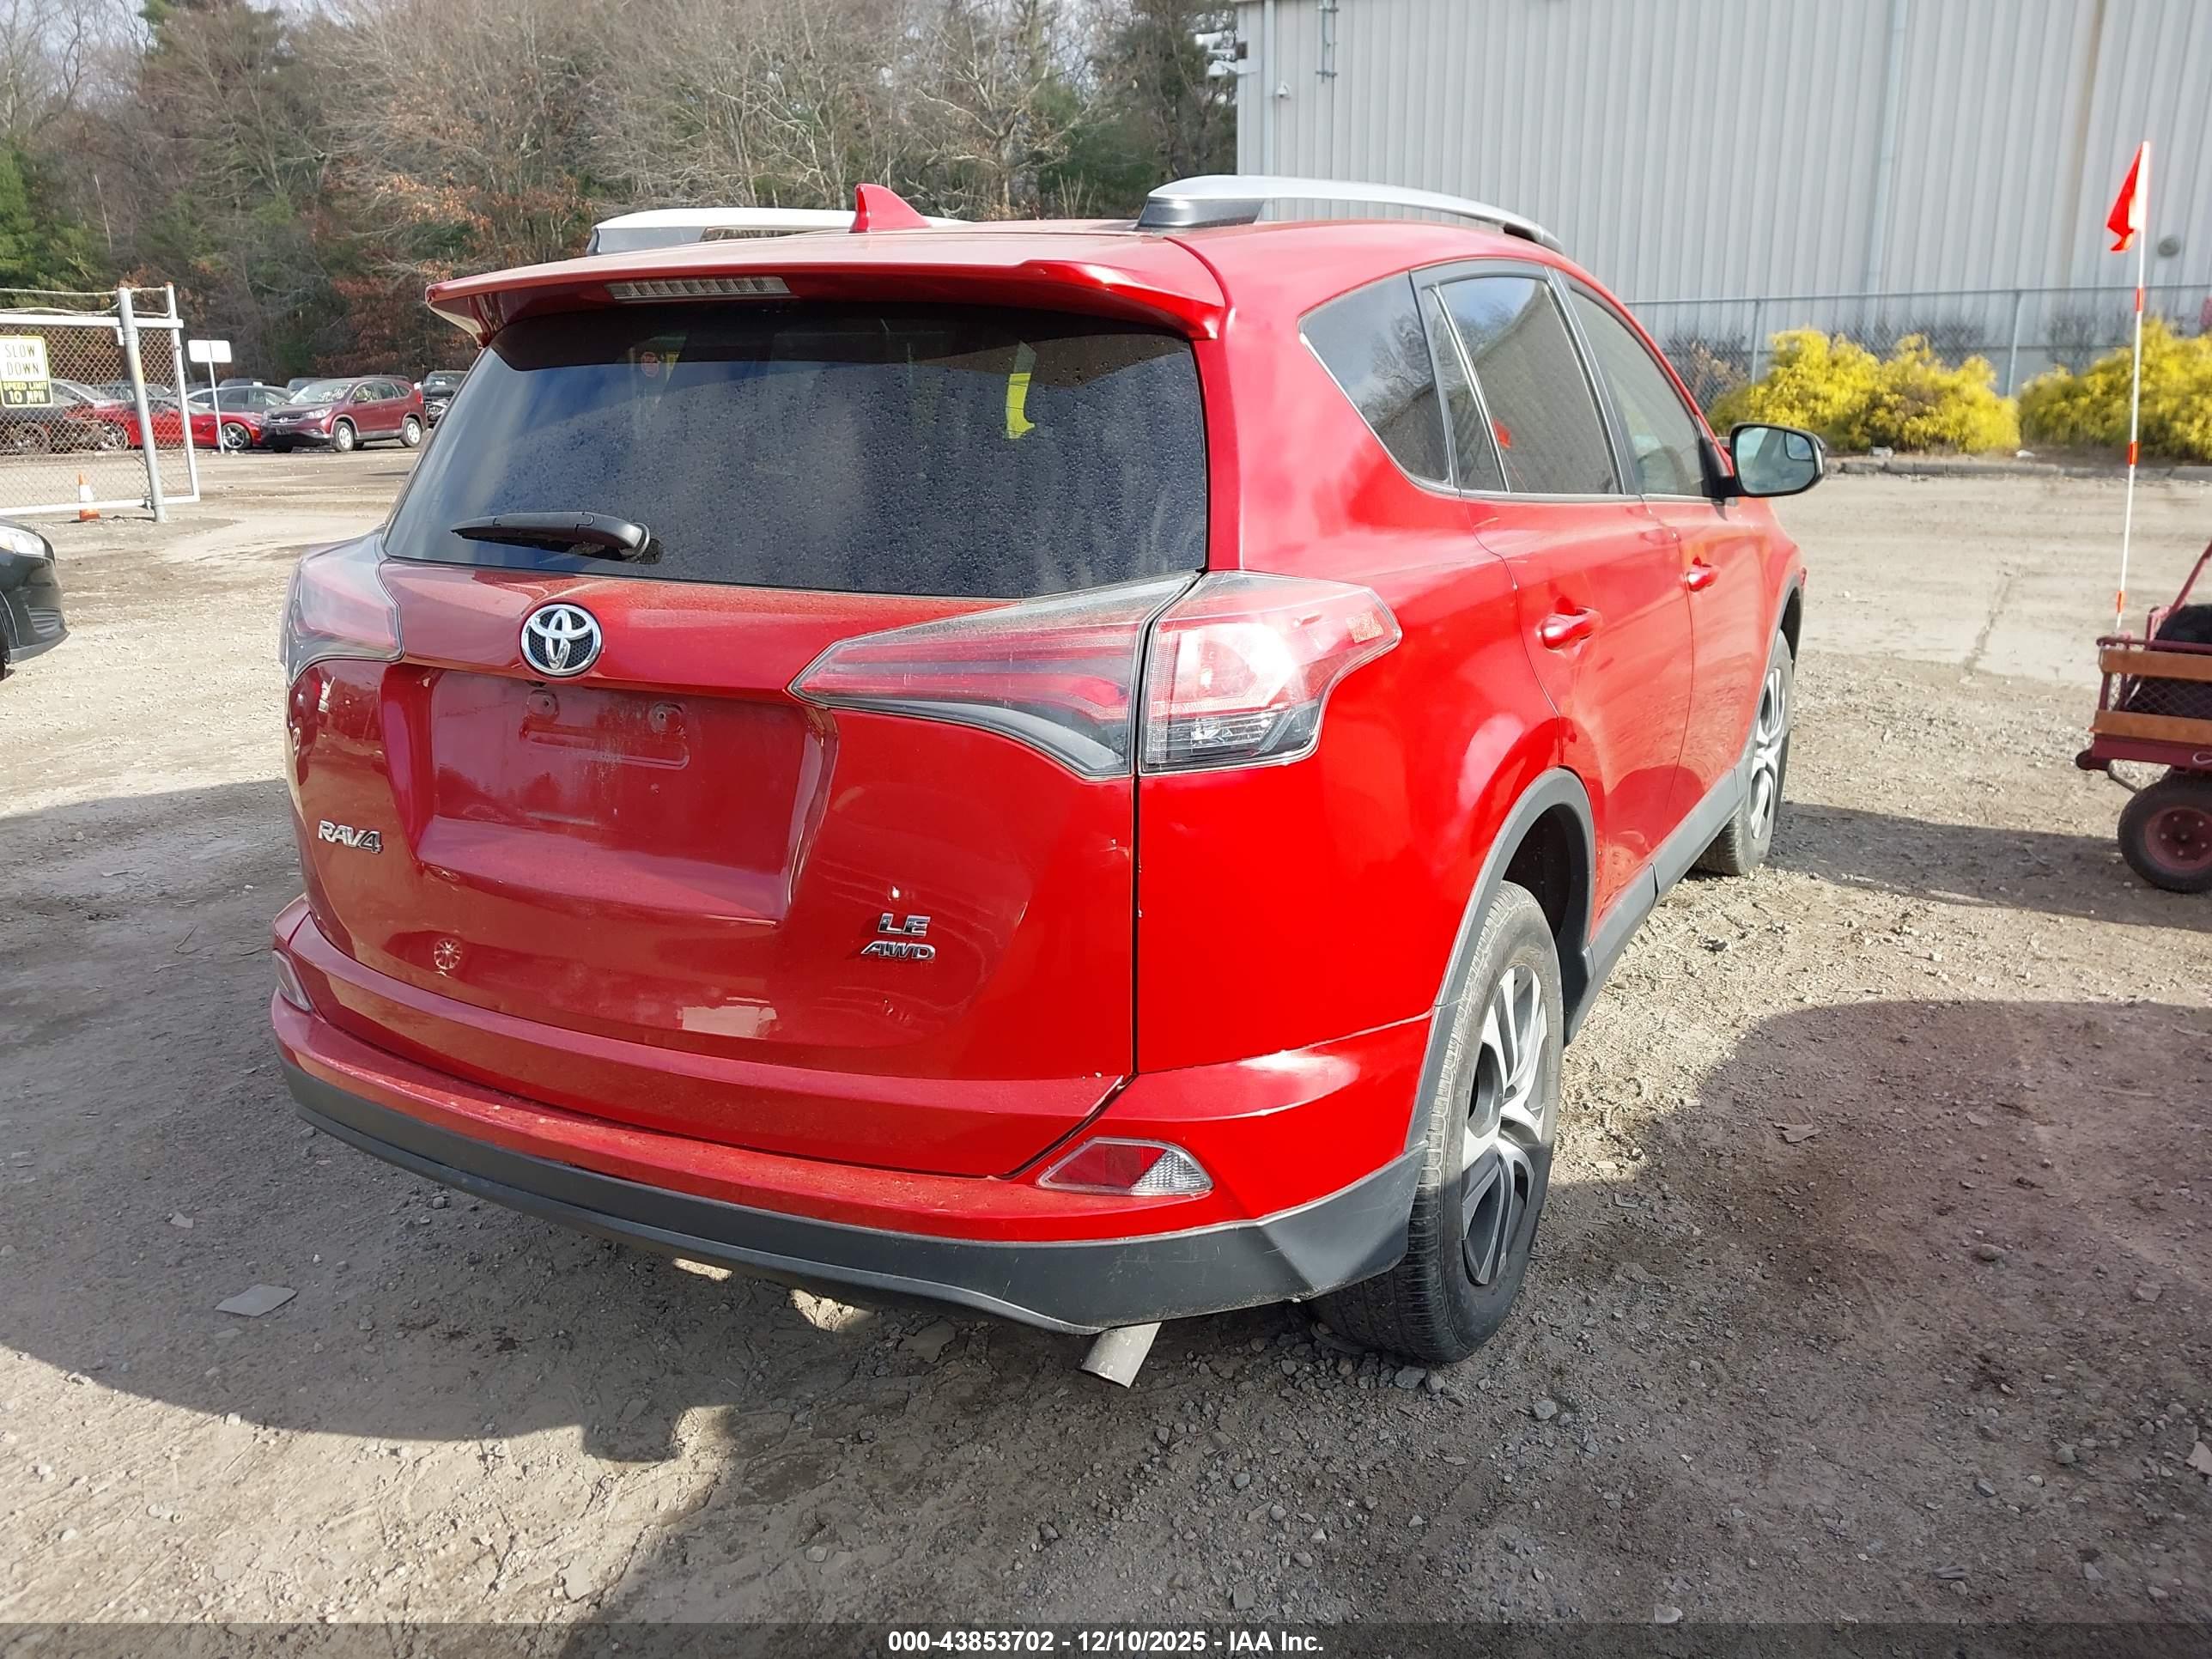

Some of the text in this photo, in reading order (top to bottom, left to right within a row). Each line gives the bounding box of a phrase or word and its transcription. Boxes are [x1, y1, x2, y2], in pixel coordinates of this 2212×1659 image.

[5, 343, 35, 357] SLOW
[6, 362, 40, 375] DOWN
[3, 382, 27, 391] SPEED
[9, 390, 46, 404] 10 MPH
[318, 819, 383, 854] RAV4
[878, 913, 931, 937] LE
[860, 940, 936, 960] AWD
